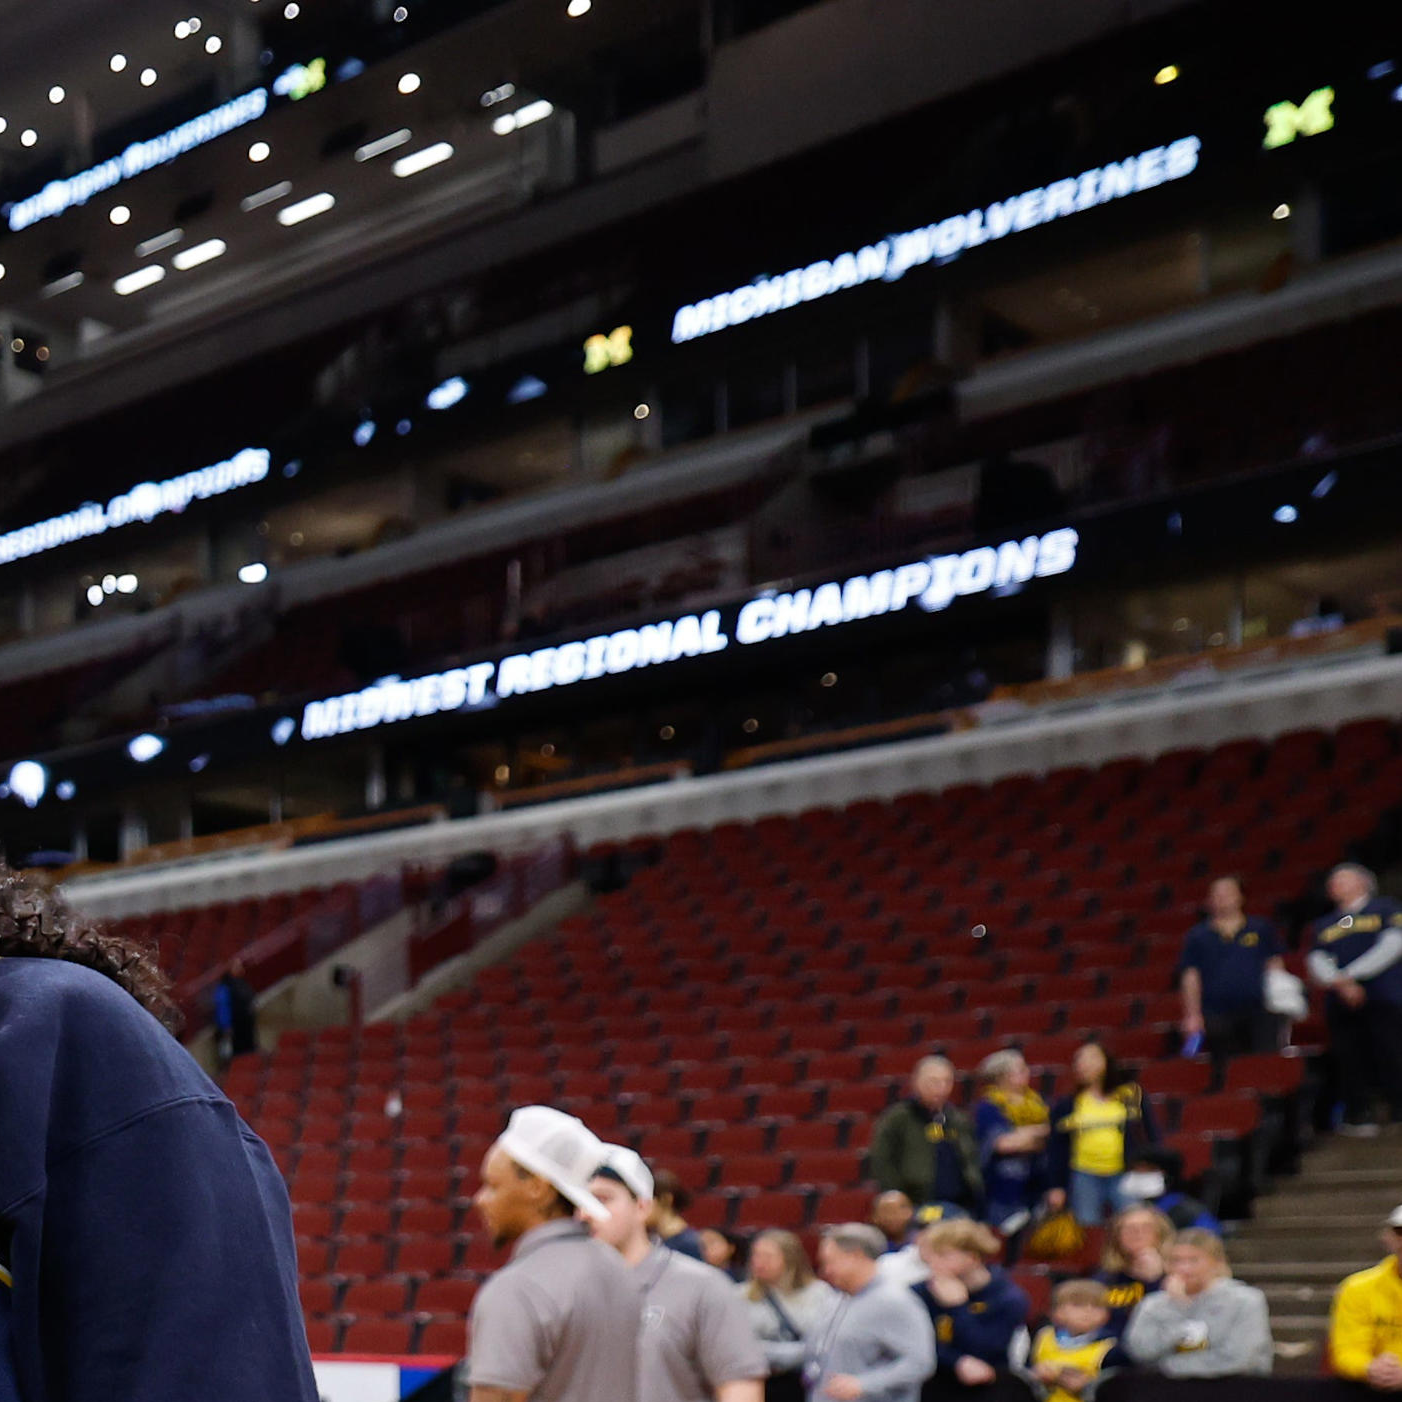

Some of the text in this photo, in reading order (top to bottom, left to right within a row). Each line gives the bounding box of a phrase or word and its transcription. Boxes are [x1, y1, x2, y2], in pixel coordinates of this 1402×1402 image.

[1263, 86, 1336, 150] M
[671, 134, 1201, 343] MICHIGAN WOLVERINES
[583, 325, 634, 374] M
[301, 526, 1080, 741] MIDWEST REGIONAL CHAMPIONS
